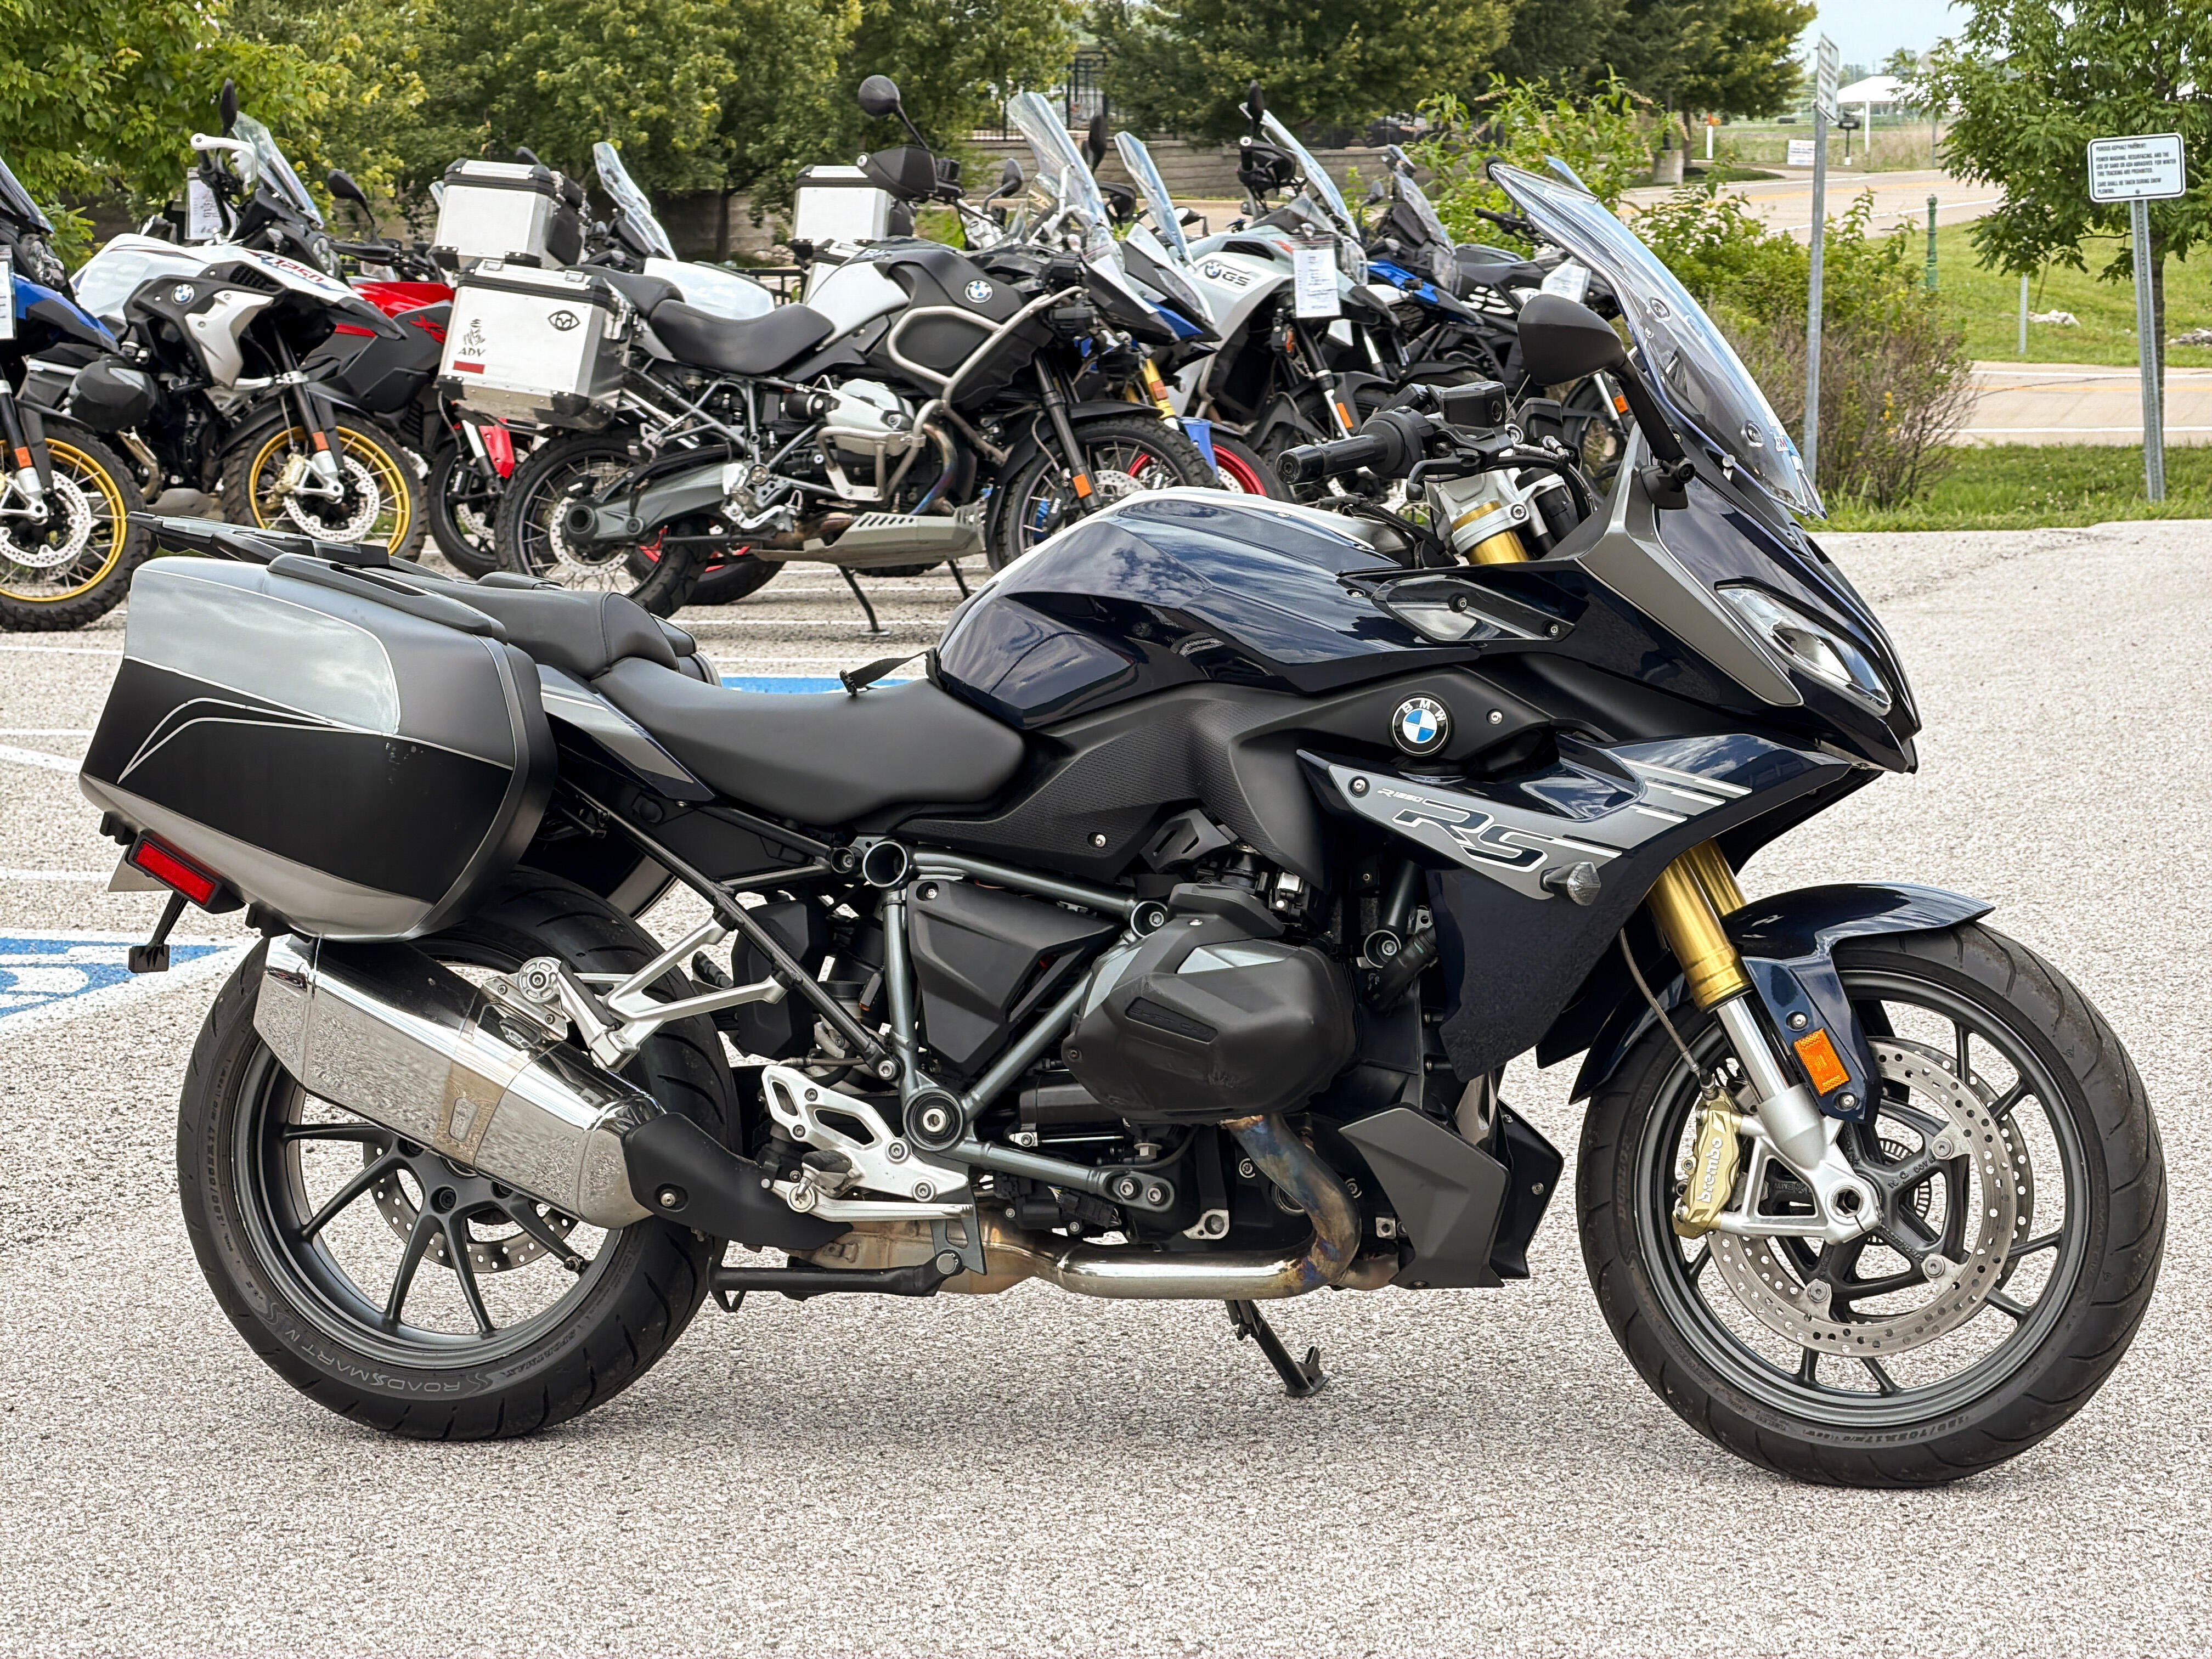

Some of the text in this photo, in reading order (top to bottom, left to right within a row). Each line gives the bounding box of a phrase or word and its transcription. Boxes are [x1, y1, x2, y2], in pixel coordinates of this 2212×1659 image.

[1222, 272, 1251, 286] GS
[458, 347, 486, 357] ADV
[1402, 699, 1446, 721] BMW
[1391, 798, 1556, 873] RS
[1696, 1137, 1723, 1203] brembo
[284, 1326, 460, 1392] ROADSMART IV
